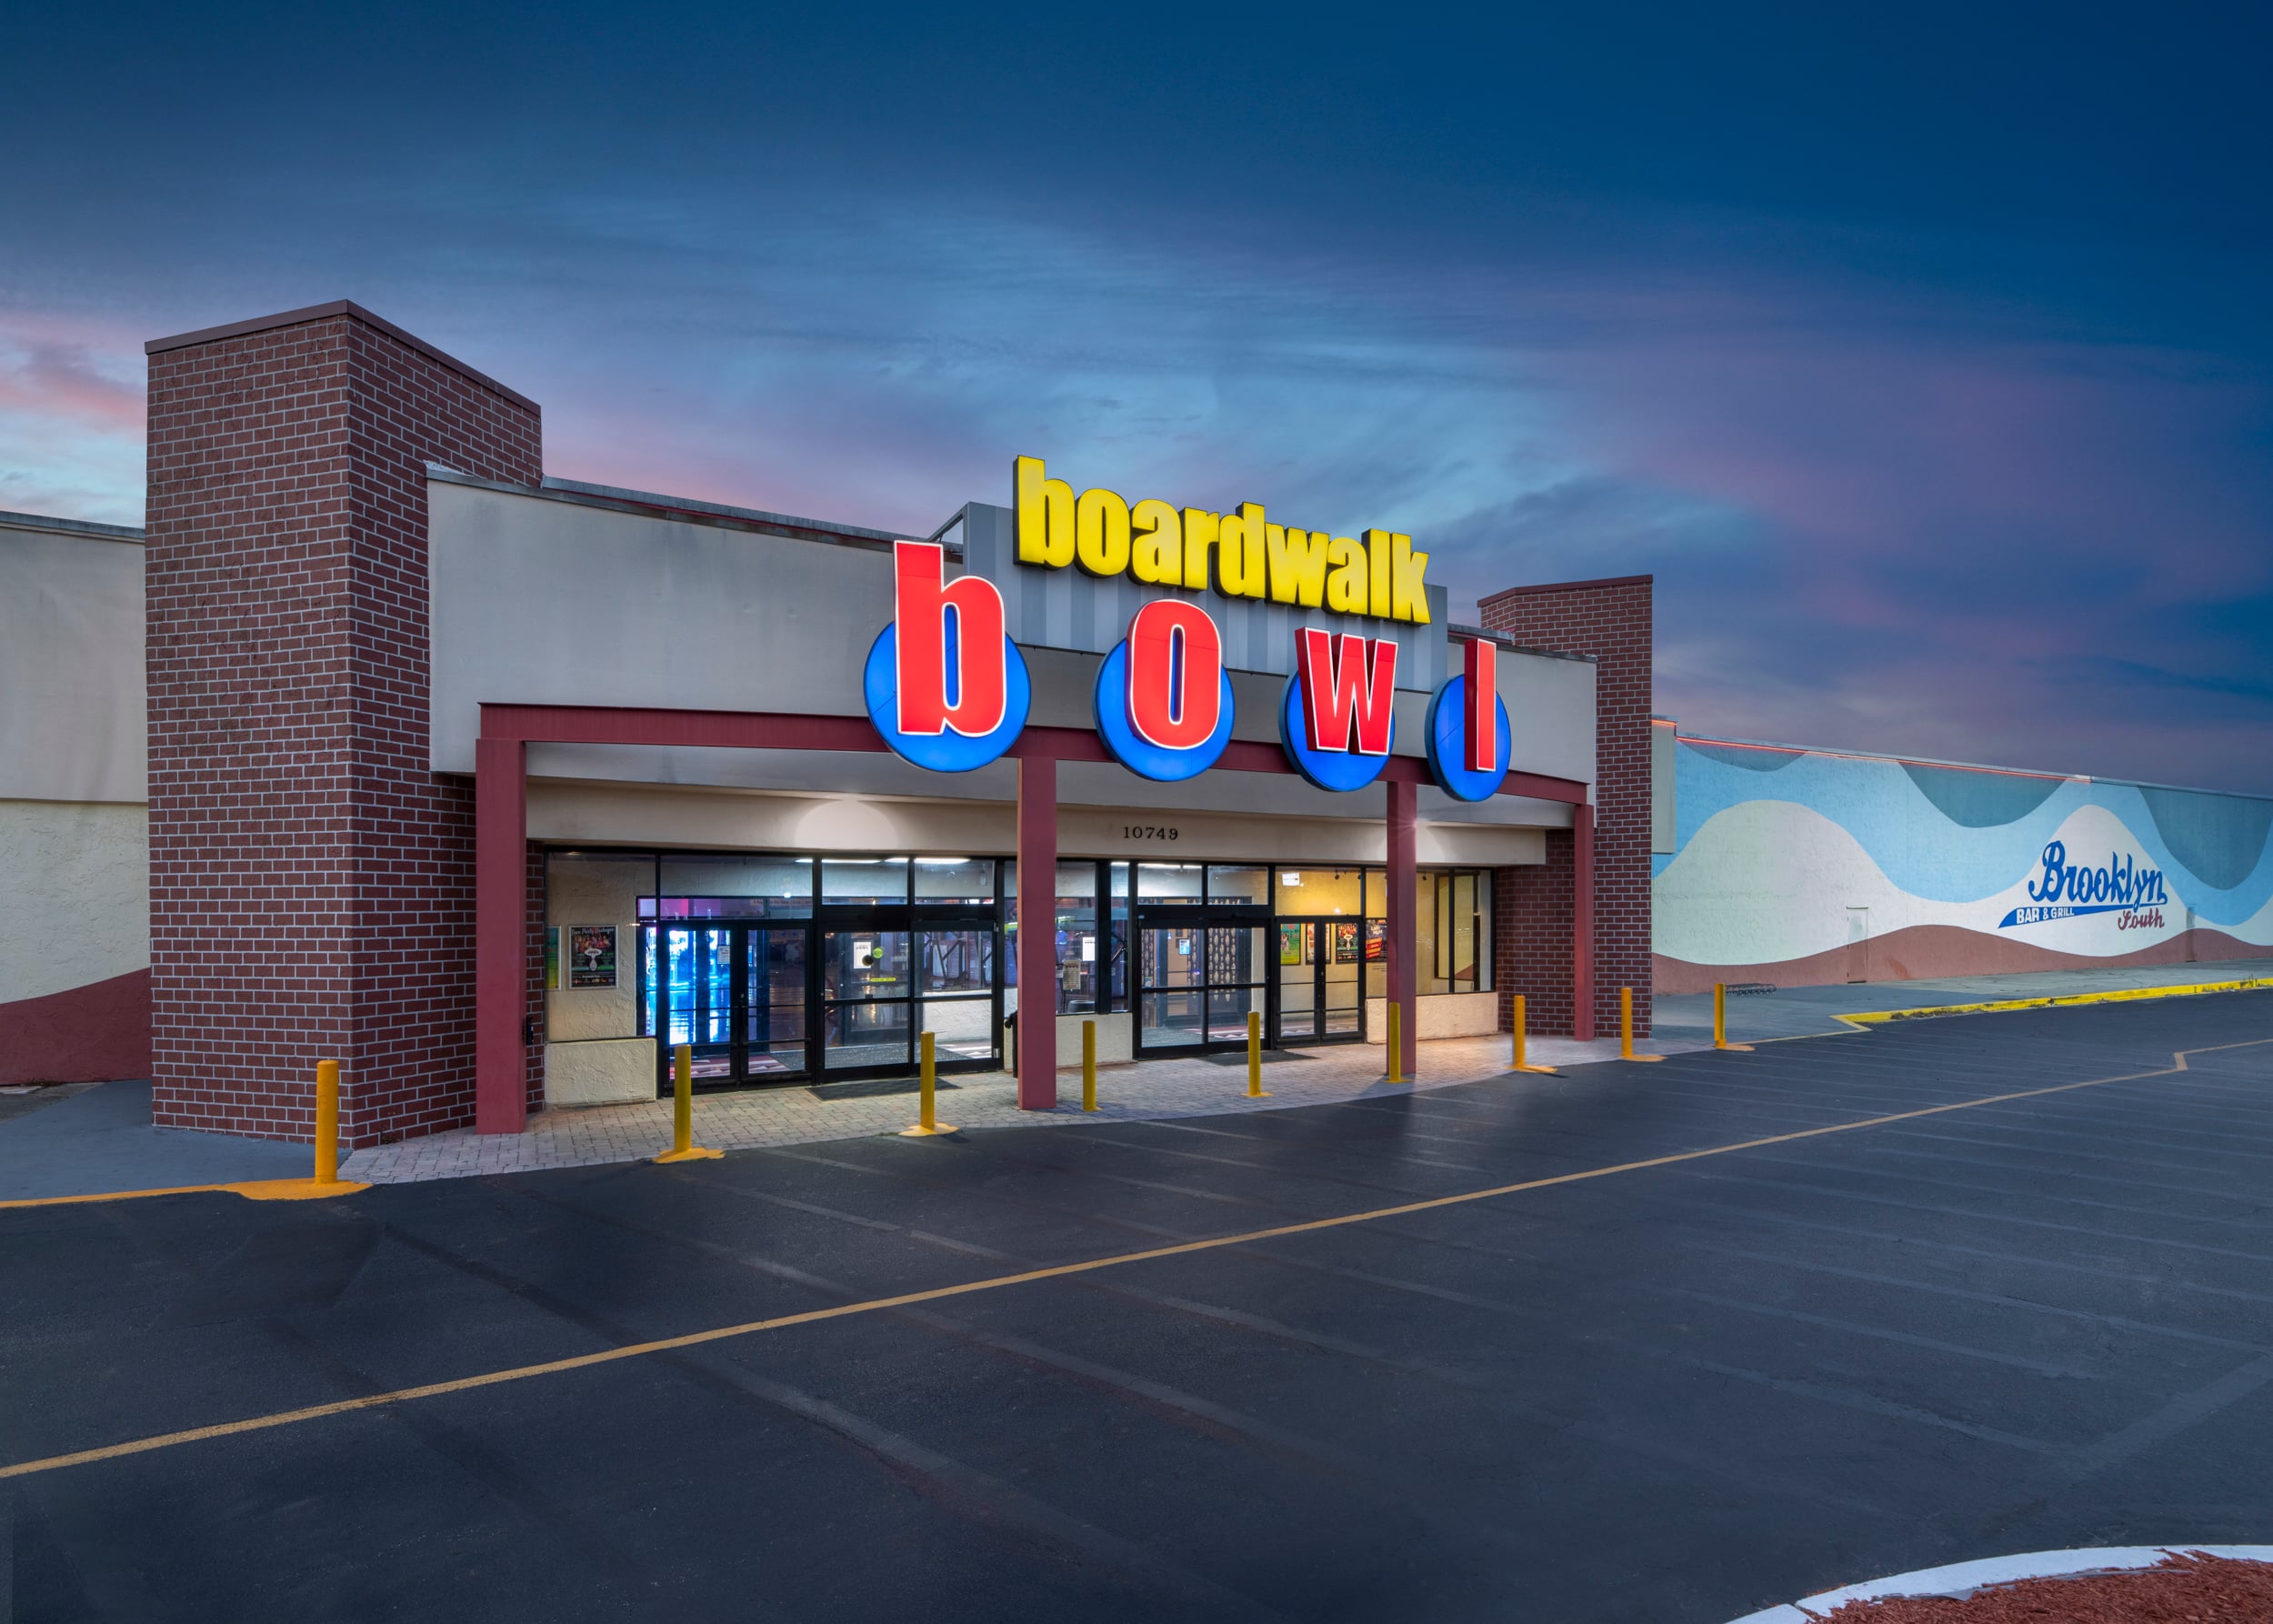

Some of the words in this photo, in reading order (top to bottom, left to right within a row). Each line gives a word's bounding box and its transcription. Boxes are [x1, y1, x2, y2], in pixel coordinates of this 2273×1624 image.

[1013, 456, 1431, 625] boardwalk
[895, 540, 1497, 772] bowl
[1124, 826, 1178, 840] 10749
[2028, 840, 2168, 912] Brooklyn
[2016, 907, 2039, 925] BAR
[2043, 907, 2049, 920] &
[2051, 907, 2075, 918] GRILL
[2118, 907, 2165, 930] South
